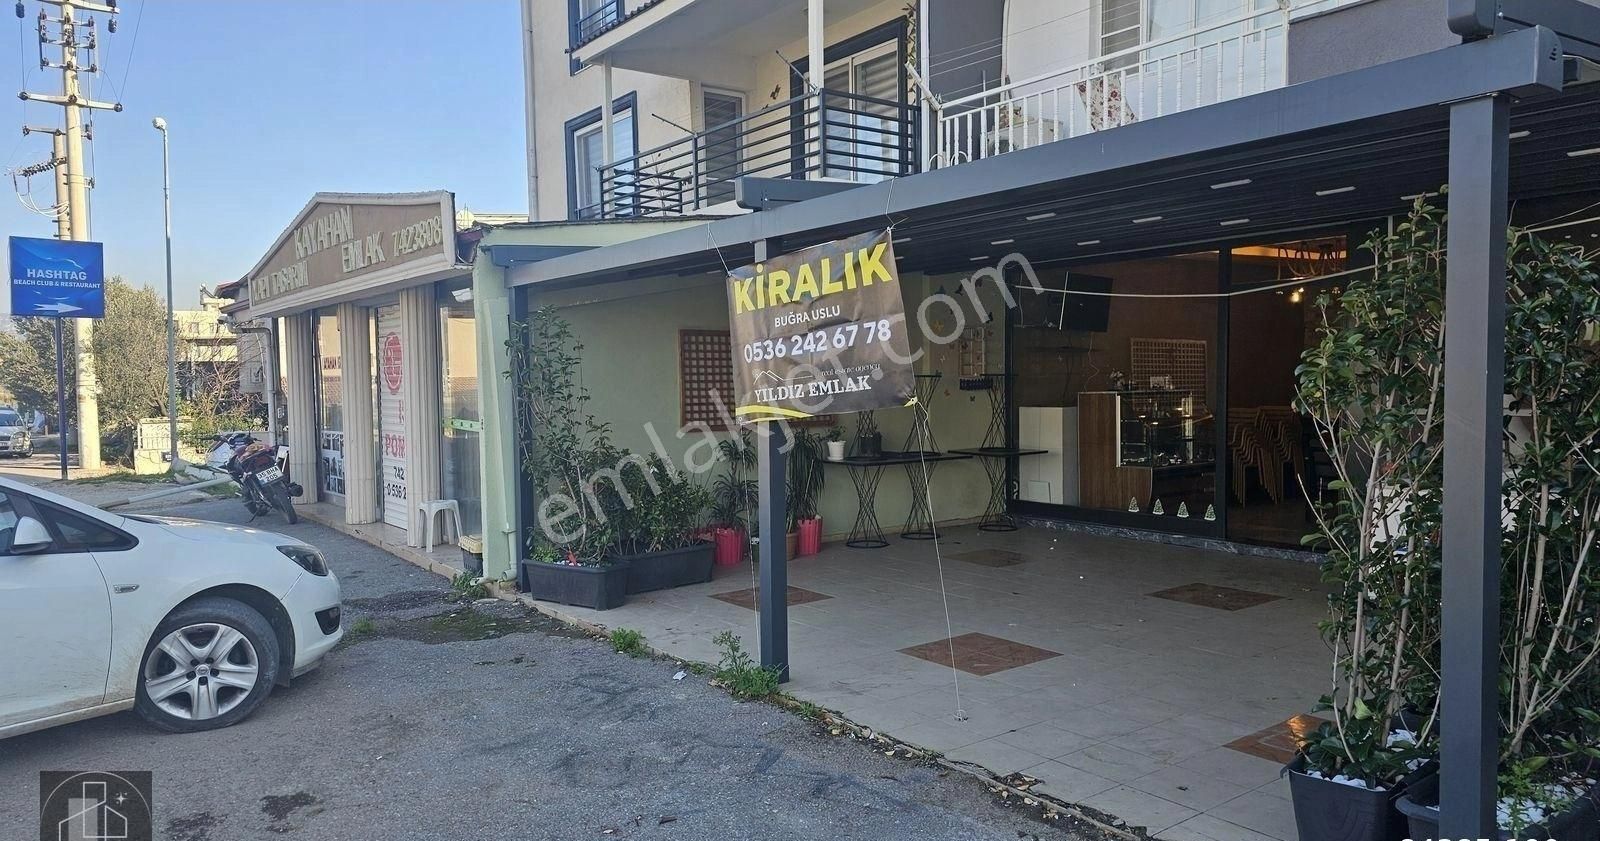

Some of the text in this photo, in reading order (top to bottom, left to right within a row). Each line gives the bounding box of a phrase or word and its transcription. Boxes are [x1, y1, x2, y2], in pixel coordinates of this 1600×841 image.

[293, 205, 354, 260] KAYAHAN
[342, 231, 386, 273] EMLAK
[27, 268, 87, 281] HASHTAG
[60, 281, 101, 289] RESTAURANT
[733, 242, 893, 315] KİRALIK
[774, 305, 841, 328] BUĞRA USLU
[744, 319, 892, 363] 0536 242 67 78
[754, 375, 872, 403] YILDIZ EMLAK
